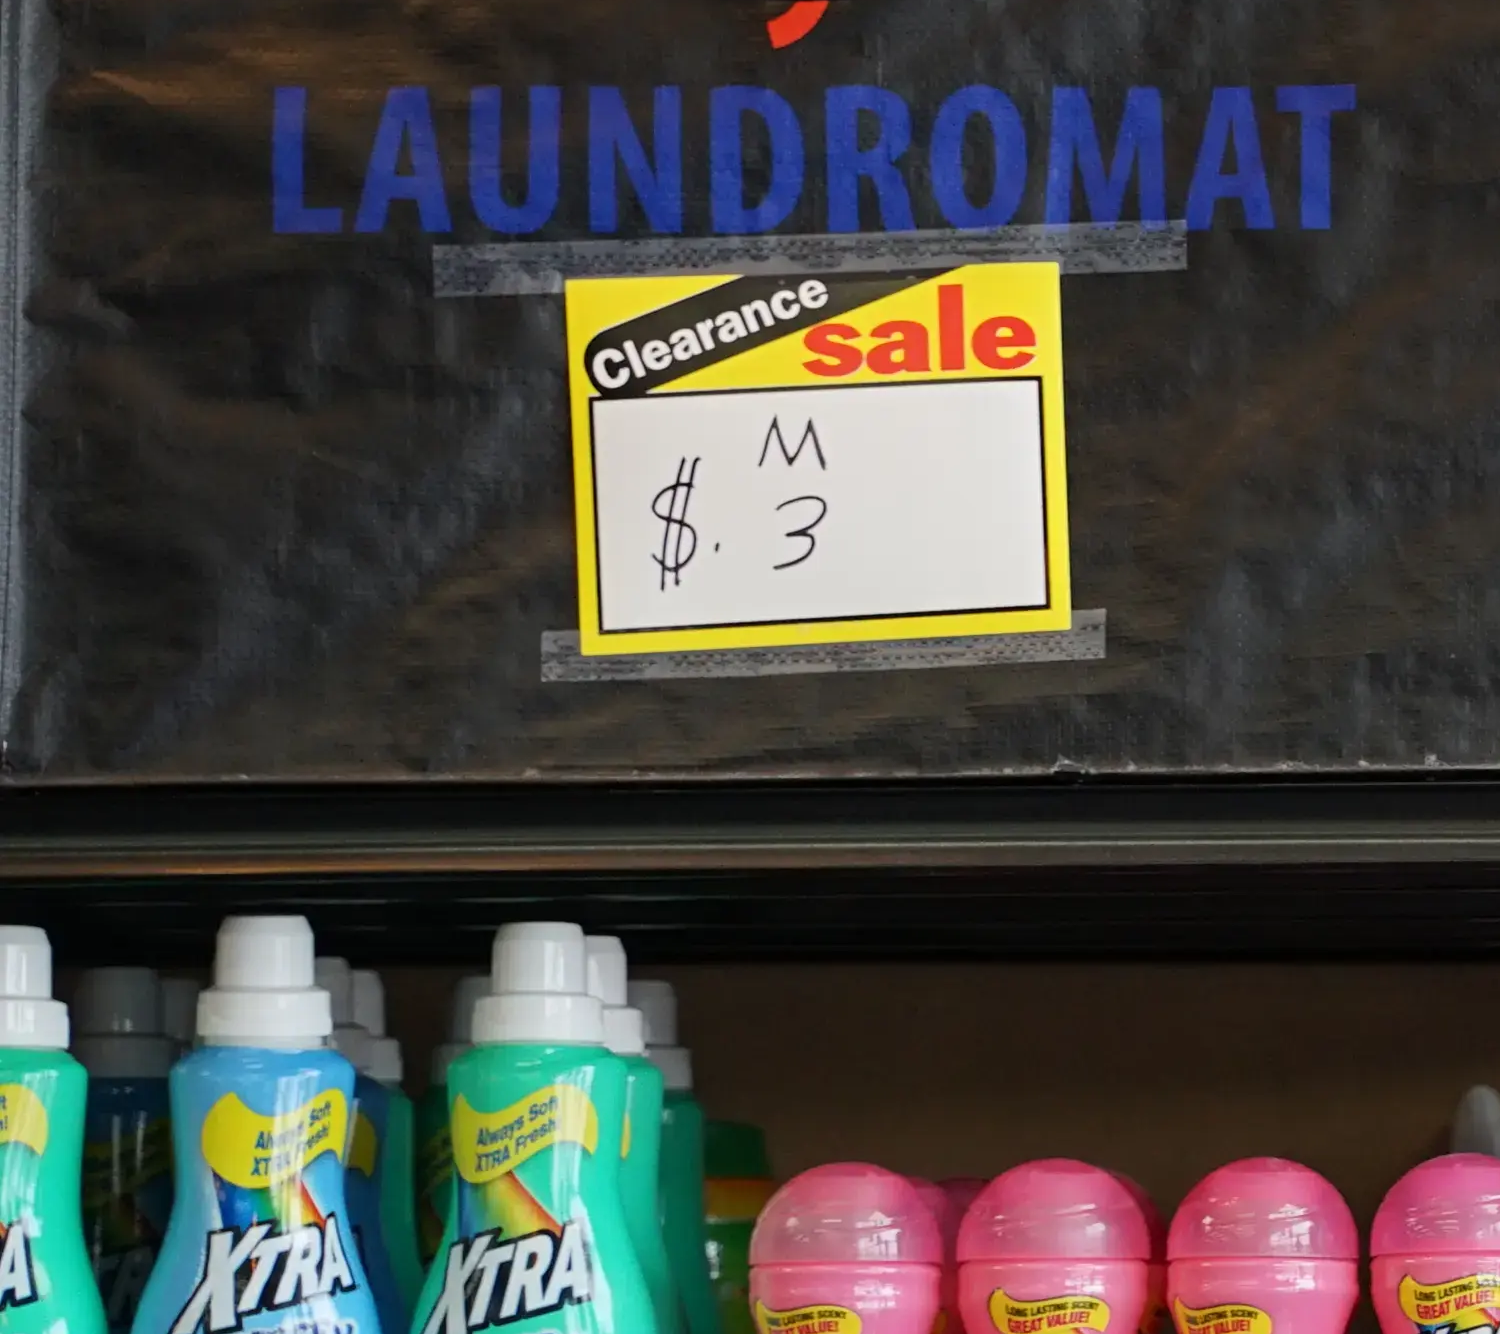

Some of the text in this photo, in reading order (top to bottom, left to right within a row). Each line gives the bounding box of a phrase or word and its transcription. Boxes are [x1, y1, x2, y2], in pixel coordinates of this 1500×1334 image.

[270, 83, 1358, 236] LAUNDROMAT
[589, 278, 829, 393] Clearance
[802, 283, 1037, 377] sale
[759, 415, 827, 470] M
[773, 496, 827, 570] 3
